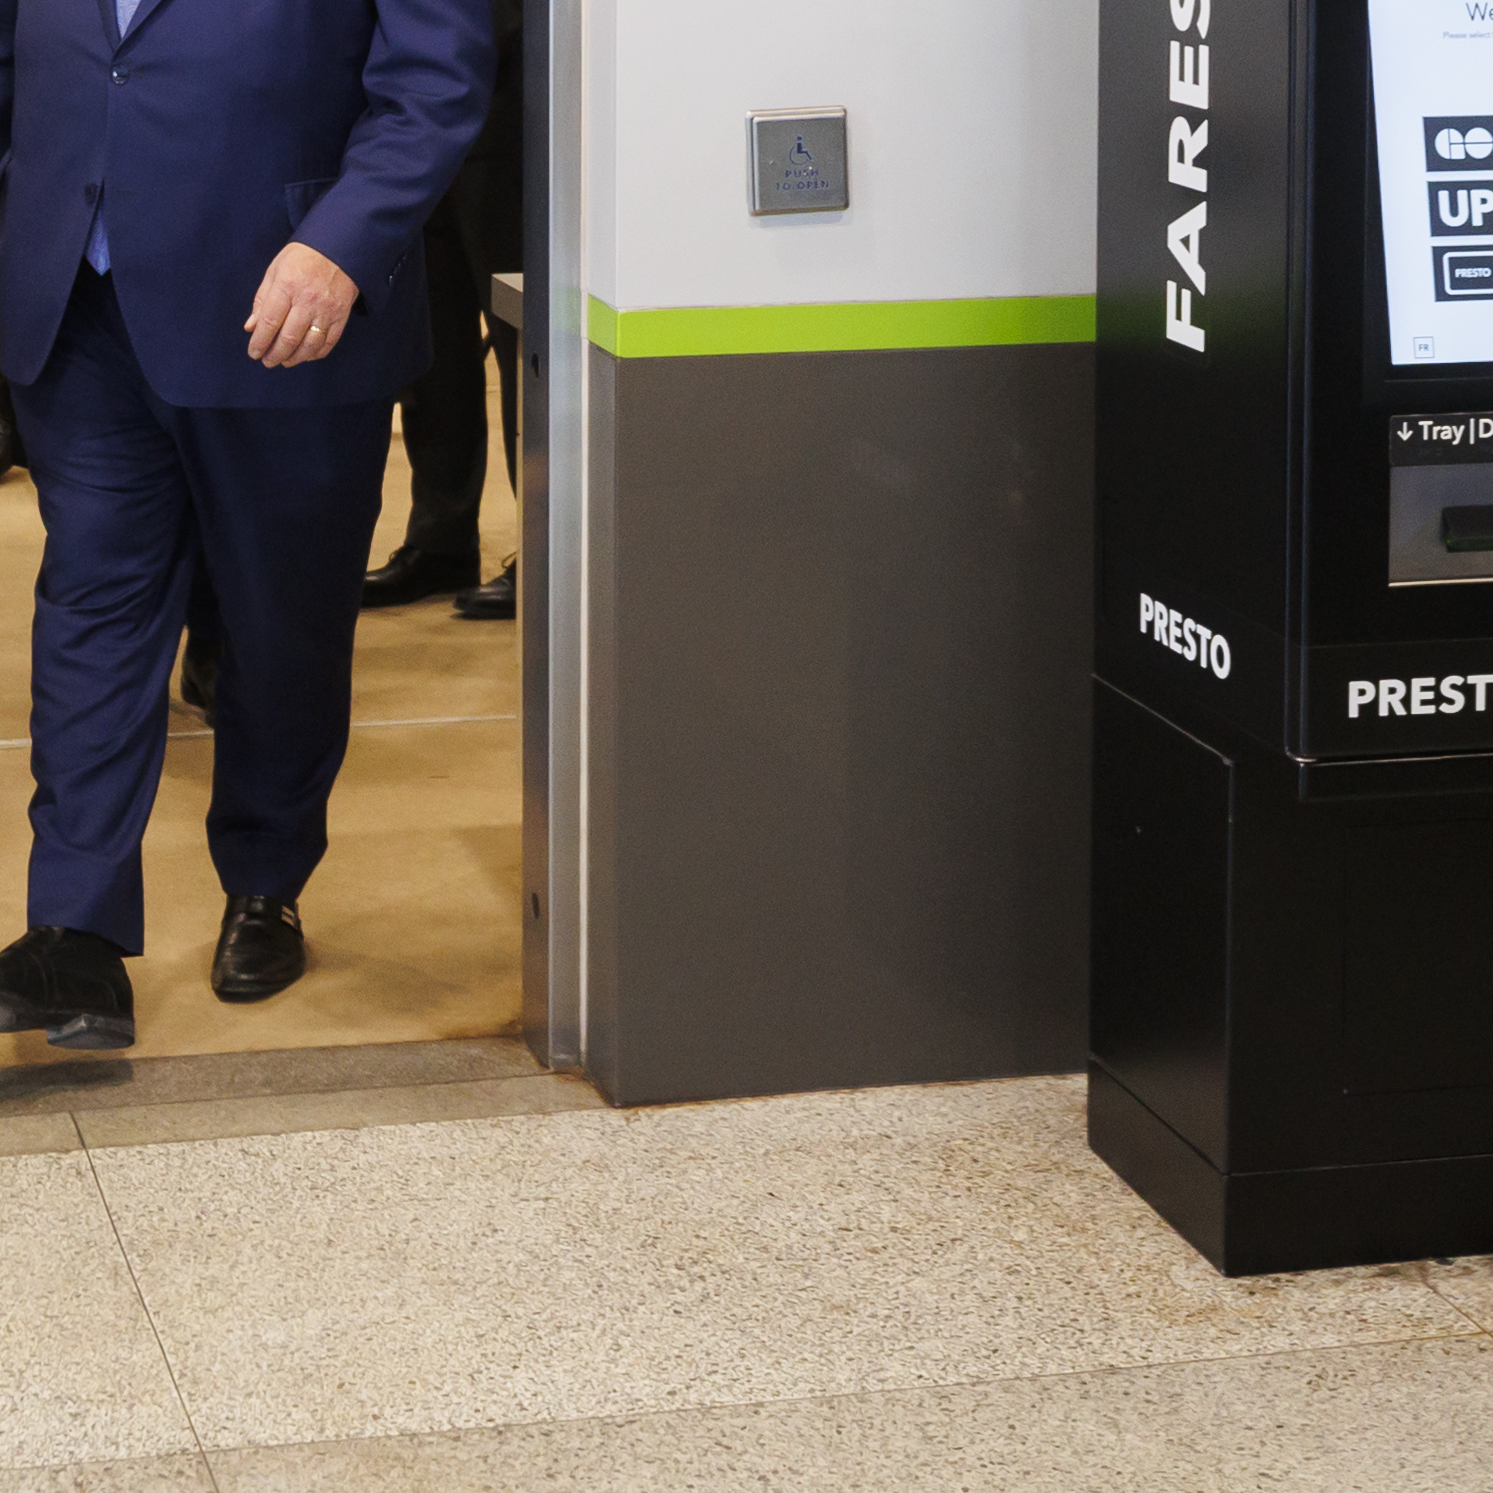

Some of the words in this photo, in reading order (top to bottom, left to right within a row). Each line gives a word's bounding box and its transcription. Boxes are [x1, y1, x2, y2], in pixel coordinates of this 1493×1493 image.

[1455, 267, 1492, 278] PRESTO
[1418, 343, 1429, 352] FR
[1417, 420, 1466, 446] Tray
[1139, 592, 1231, 680] PRESTO
